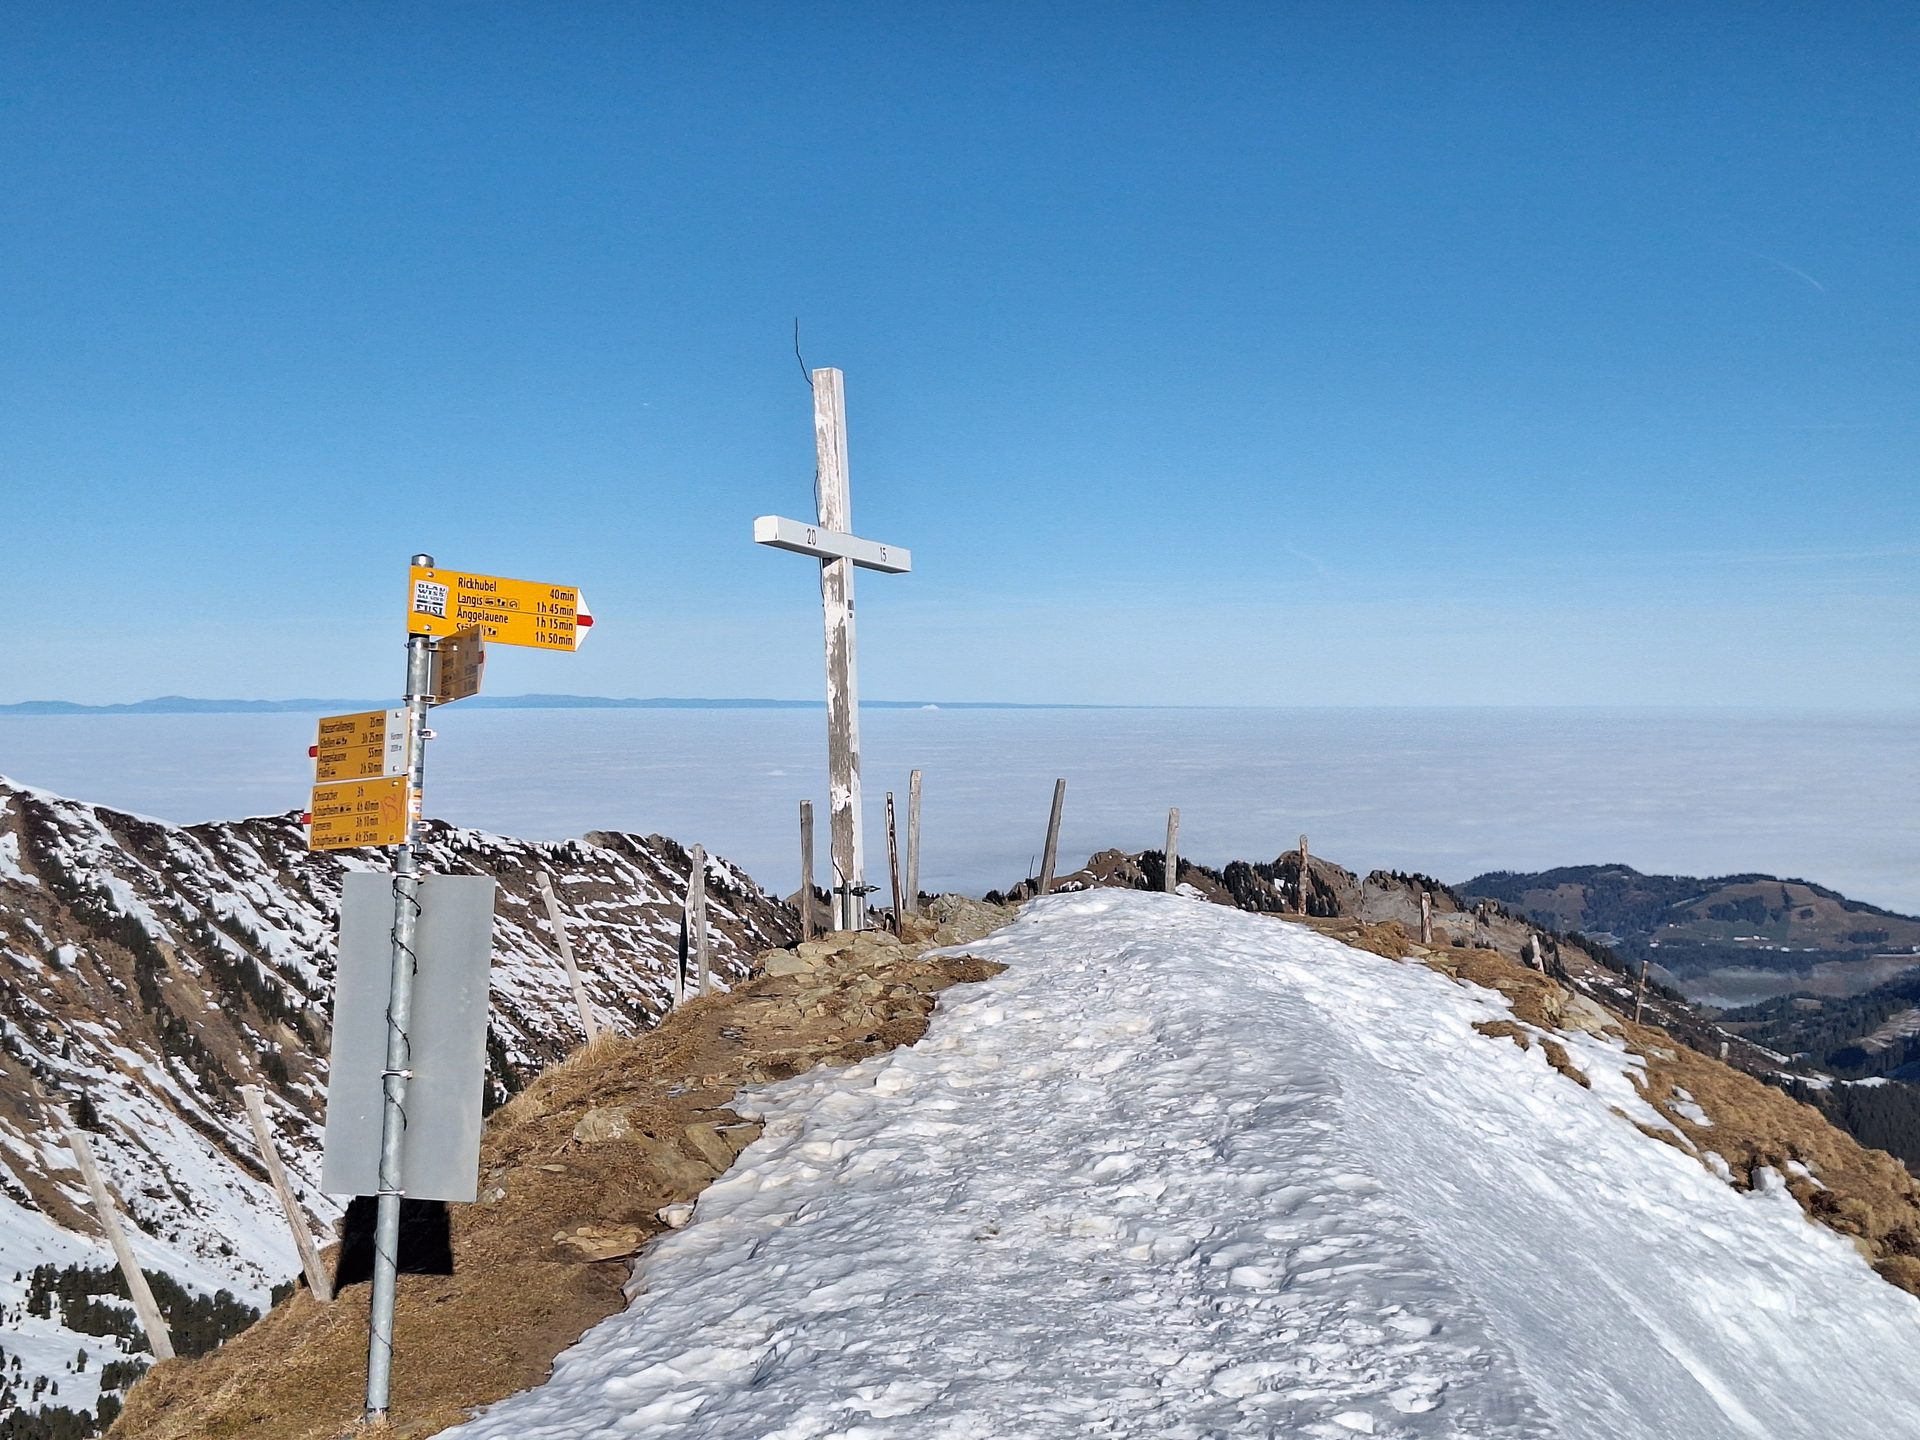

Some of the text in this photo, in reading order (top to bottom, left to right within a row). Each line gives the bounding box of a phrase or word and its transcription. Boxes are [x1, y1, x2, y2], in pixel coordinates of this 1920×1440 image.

[807, 528, 817, 546] 20
[880, 547, 887, 562] 15
[458, 576, 497, 592] Rickhubel
[457, 592, 483, 606] Langis
[456, 607, 509, 624] Anggelauene
